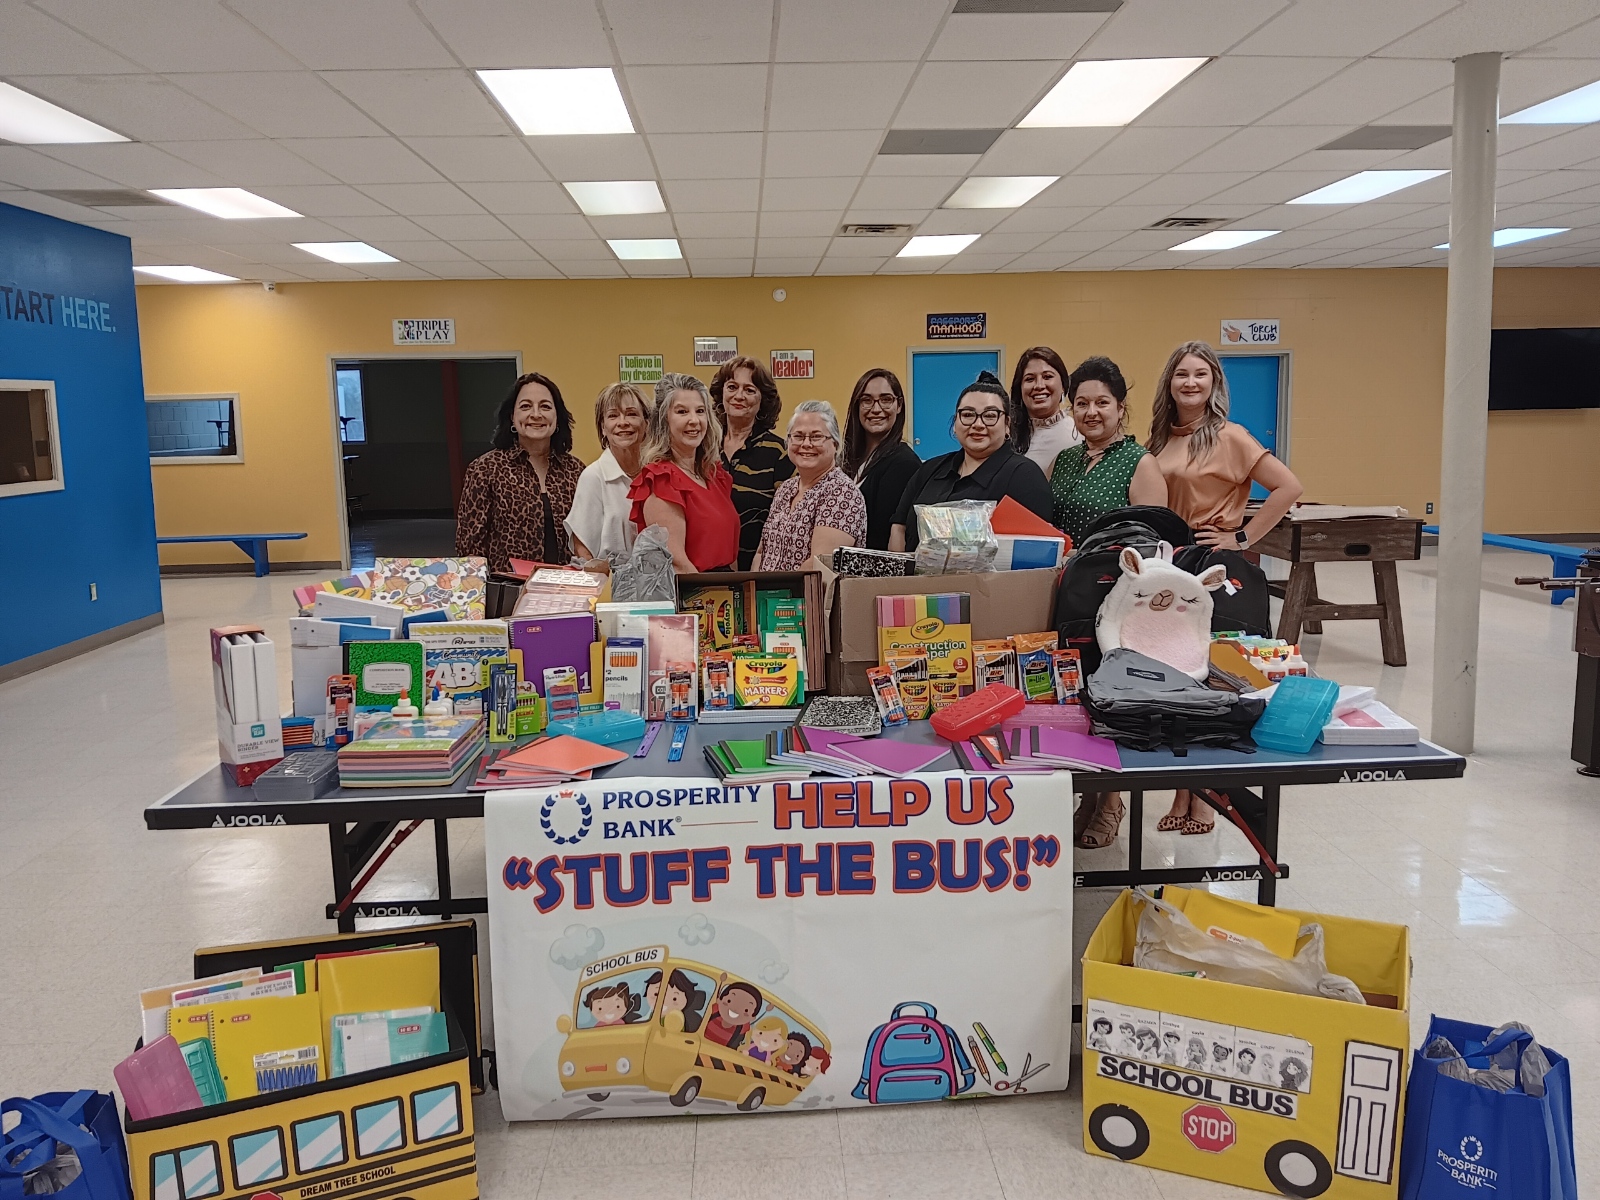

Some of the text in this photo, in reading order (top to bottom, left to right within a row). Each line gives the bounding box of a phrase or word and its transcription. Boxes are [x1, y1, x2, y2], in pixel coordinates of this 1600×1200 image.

[0, 286, 116, 332] TART HERE.
[415, 320, 450, 330] TRIPLE
[929, 324, 982, 334] MANHOOD
[1248, 322, 1277, 334] TORCH
[416, 330, 449, 340] PLAY
[1252, 333, 1276, 341] CLUB
[625, 356, 652, 368] believe
[654, 356, 661, 368] in
[772, 357, 812, 377] leader
[621, 369, 662, 382] my dreams
[916, 621, 940, 631] Crayola
[890, 639, 966, 650] Construction
[927, 650, 950, 660] aper
[1259, 649, 1286, 657] Crala
[580, 672, 590, 690] 1
[744, 686, 788, 696] MARKERS
[651, 696, 665, 712] 17
[1352, 770, 1406, 782] JOOLA
[602, 785, 761, 809] PROSPERITY
[773, 775, 1014, 829] HELP US
[226, 814, 286, 827] JOOLA
[745, 841, 876, 898] THE
[1213, 869, 1263, 881] JOOLA
[368, 906, 420, 917] JOOLA
[586, 949, 658, 977] SCHOOL BUS
[401, 1051, 430, 1063] FILLER
[1100, 1056, 1294, 1116] SCHOOL BUS
[1187, 1116, 1233, 1143] STOP
[300, 1166, 396, 1198] DREAM TREE SCHOOL
